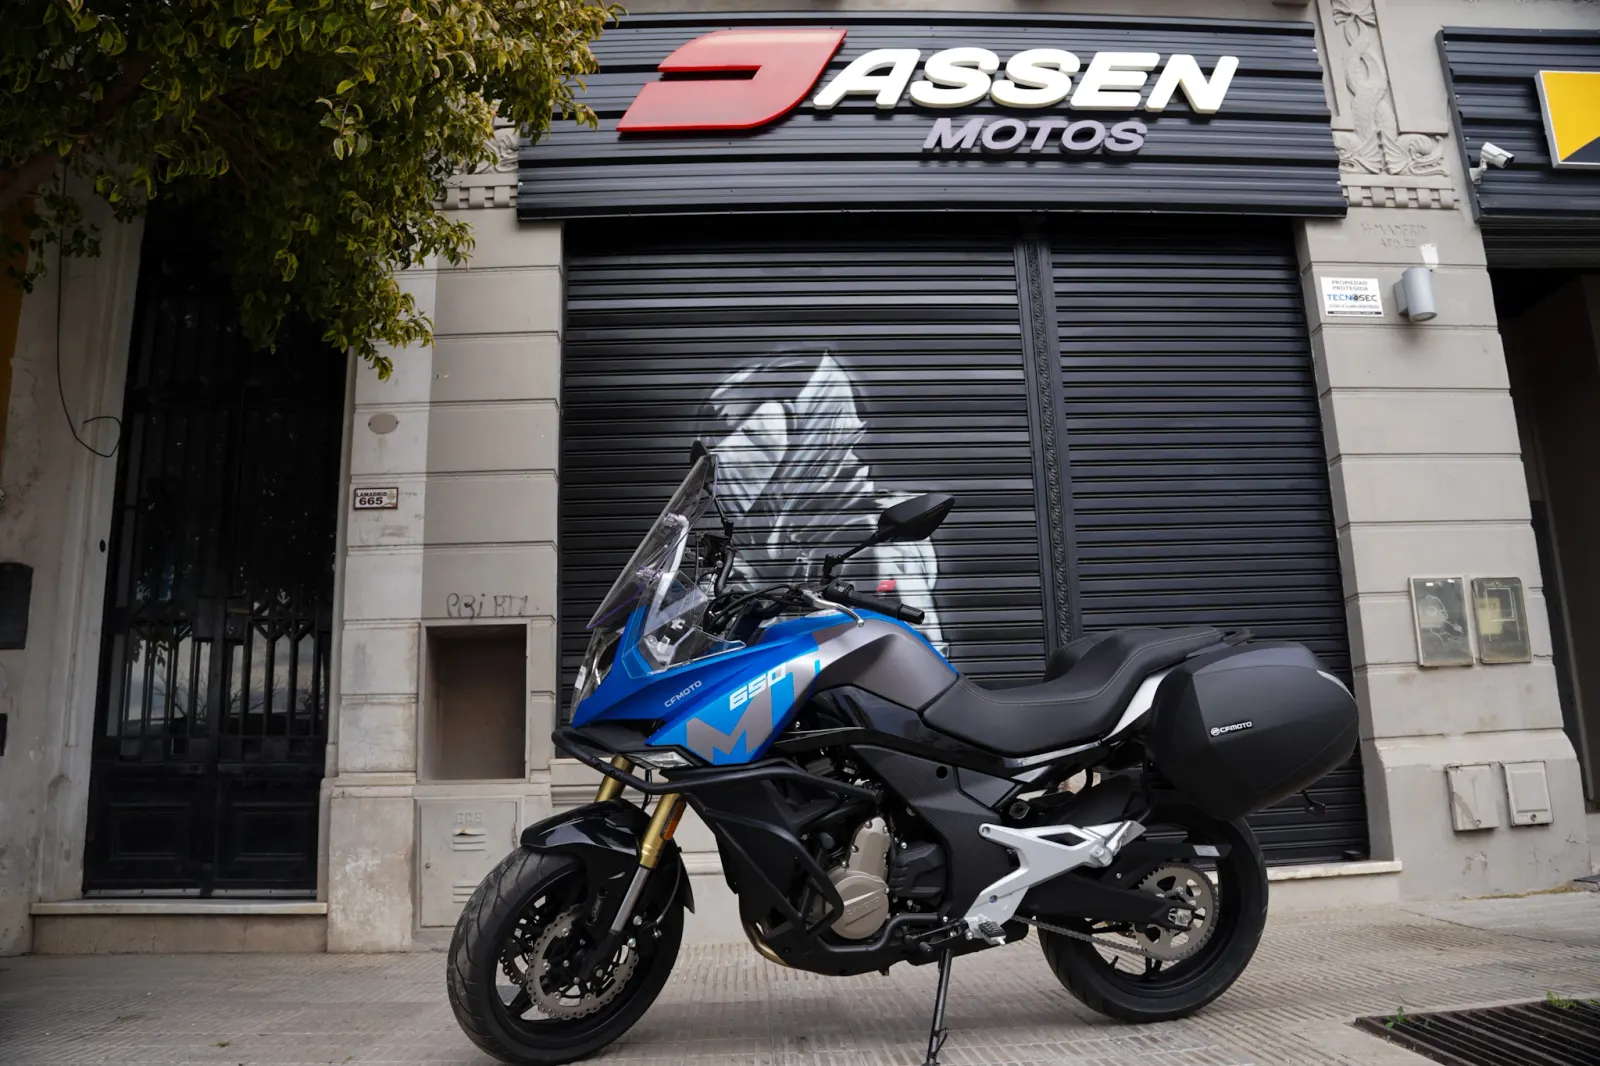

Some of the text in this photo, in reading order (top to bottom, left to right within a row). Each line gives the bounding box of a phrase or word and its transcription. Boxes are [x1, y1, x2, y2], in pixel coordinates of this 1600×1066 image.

[813, 47, 1240, 114] ASSEN
[922, 117, 1148, 155] MOTOS
[359, 497, 383, 505] 665
[664, 680, 702, 708] CFMOTO
[729, 662, 787, 711] 650
[1220, 721, 1253, 733] CFMOTO
